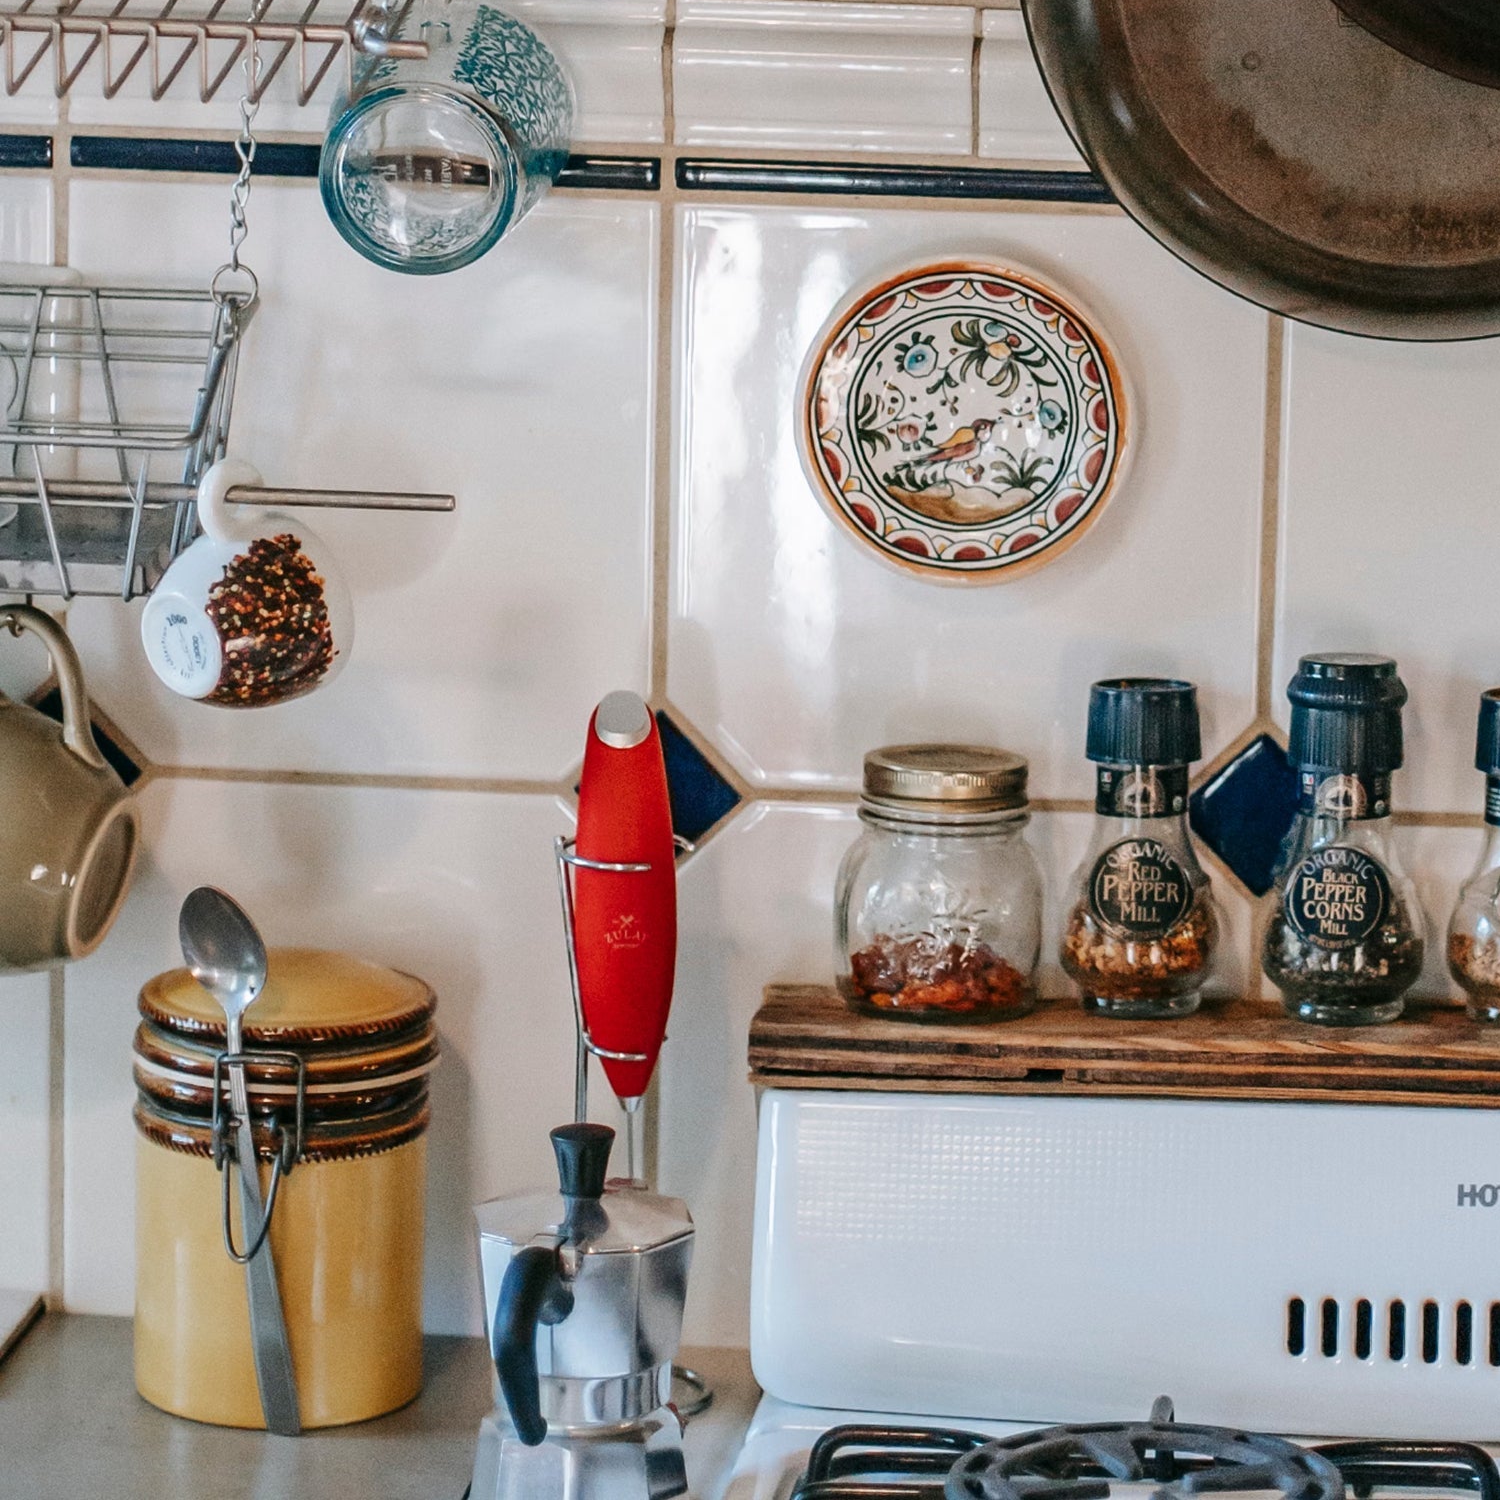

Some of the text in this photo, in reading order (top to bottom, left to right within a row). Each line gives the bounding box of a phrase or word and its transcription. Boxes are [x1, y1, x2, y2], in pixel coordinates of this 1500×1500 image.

[1128, 861, 1162, 881] RED
[1302, 849, 1374, 879] ORGANIC
[1322, 868, 1358, 884] BLACK
[1103, 874, 1179, 903] PEPPER
[1302, 877, 1367, 903] PEPPER
[1120, 901, 1160, 922] MILL
[1303, 901, 1365, 922] CORNS
[1320, 919, 1349, 936] MILL
